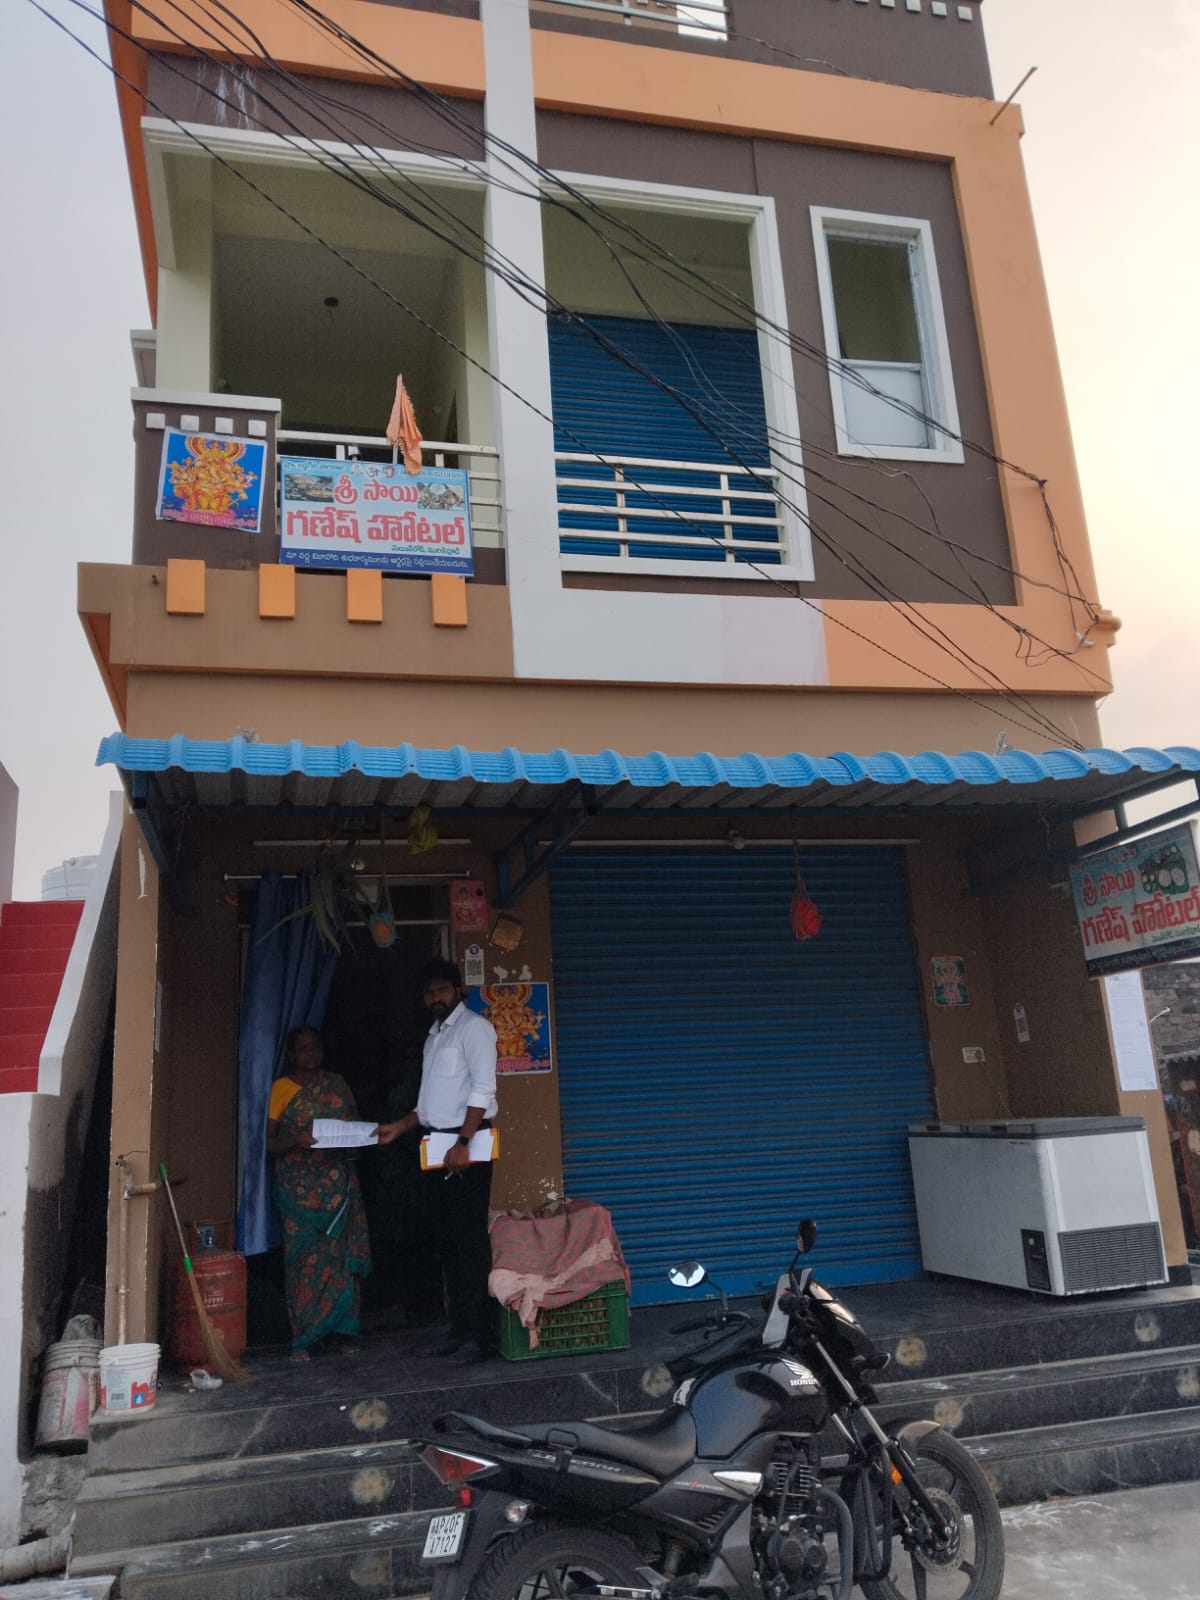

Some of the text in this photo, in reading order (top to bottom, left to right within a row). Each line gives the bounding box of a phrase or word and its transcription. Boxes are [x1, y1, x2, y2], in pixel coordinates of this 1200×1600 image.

[333, 474, 419, 505] శ్రీ సాయి
[286, 506, 362, 544] గణేష్
[367, 511, 465, 545] హోటల్
[1083, 868, 1136, 906] శ్రీ సాయి
[1082, 905, 1131, 946] గణేష్
